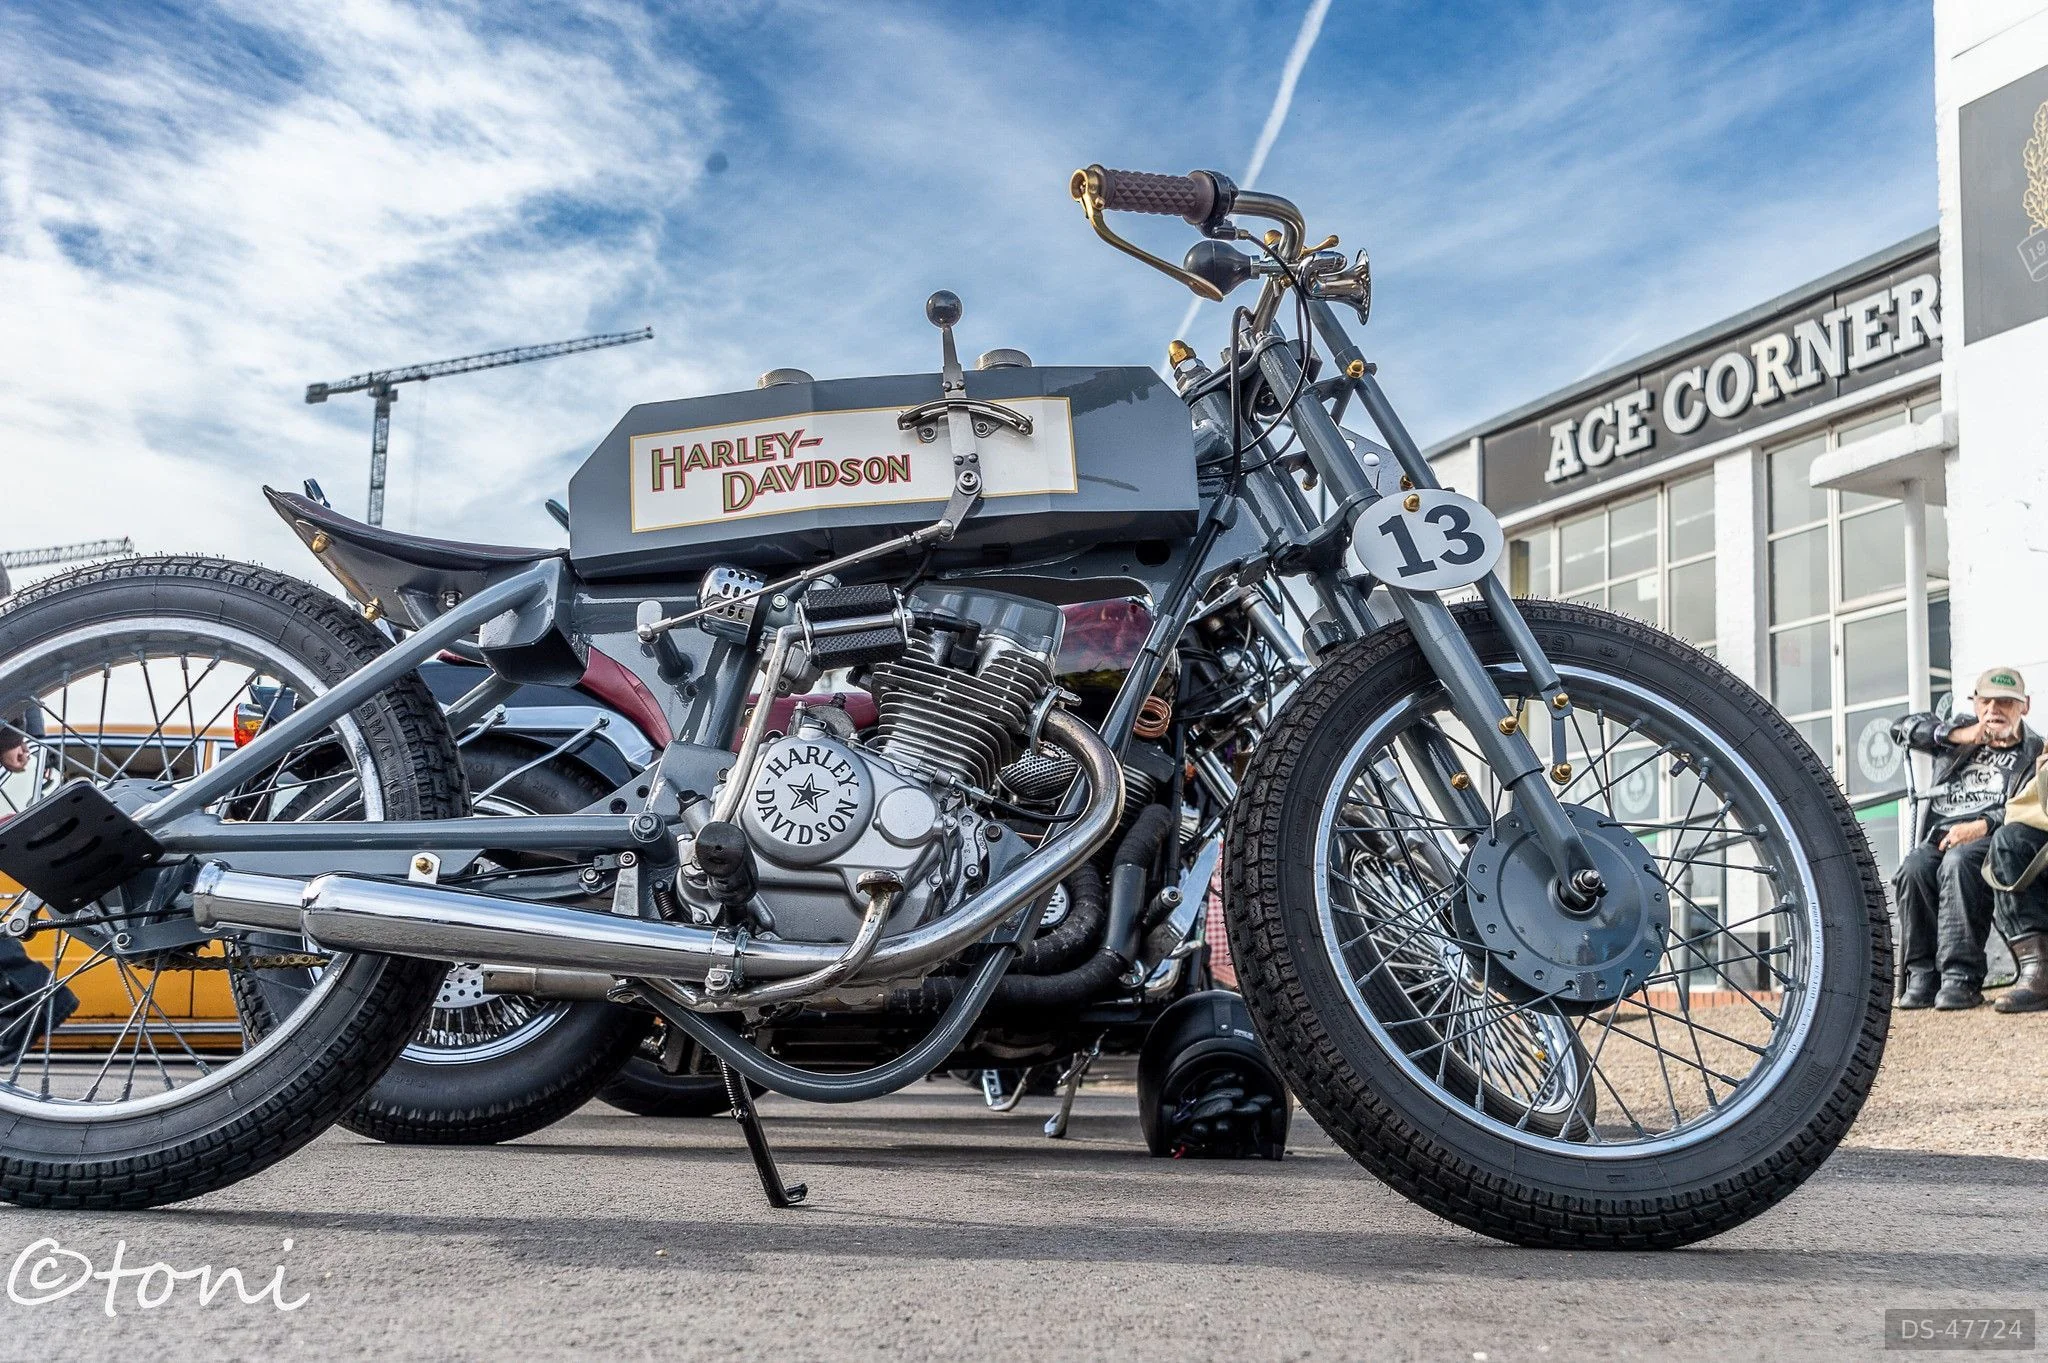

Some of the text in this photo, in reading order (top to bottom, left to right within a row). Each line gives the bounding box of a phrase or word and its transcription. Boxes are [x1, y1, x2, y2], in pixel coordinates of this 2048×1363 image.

[1545, 272, 1943, 484] ACE CORNER
[651, 429, 823, 492] HARLEY-
[722, 453, 912, 514] DAVIDSON
[1377, 504, 1486, 578] 13
[756, 788, 859, 845] DAVIDSON
